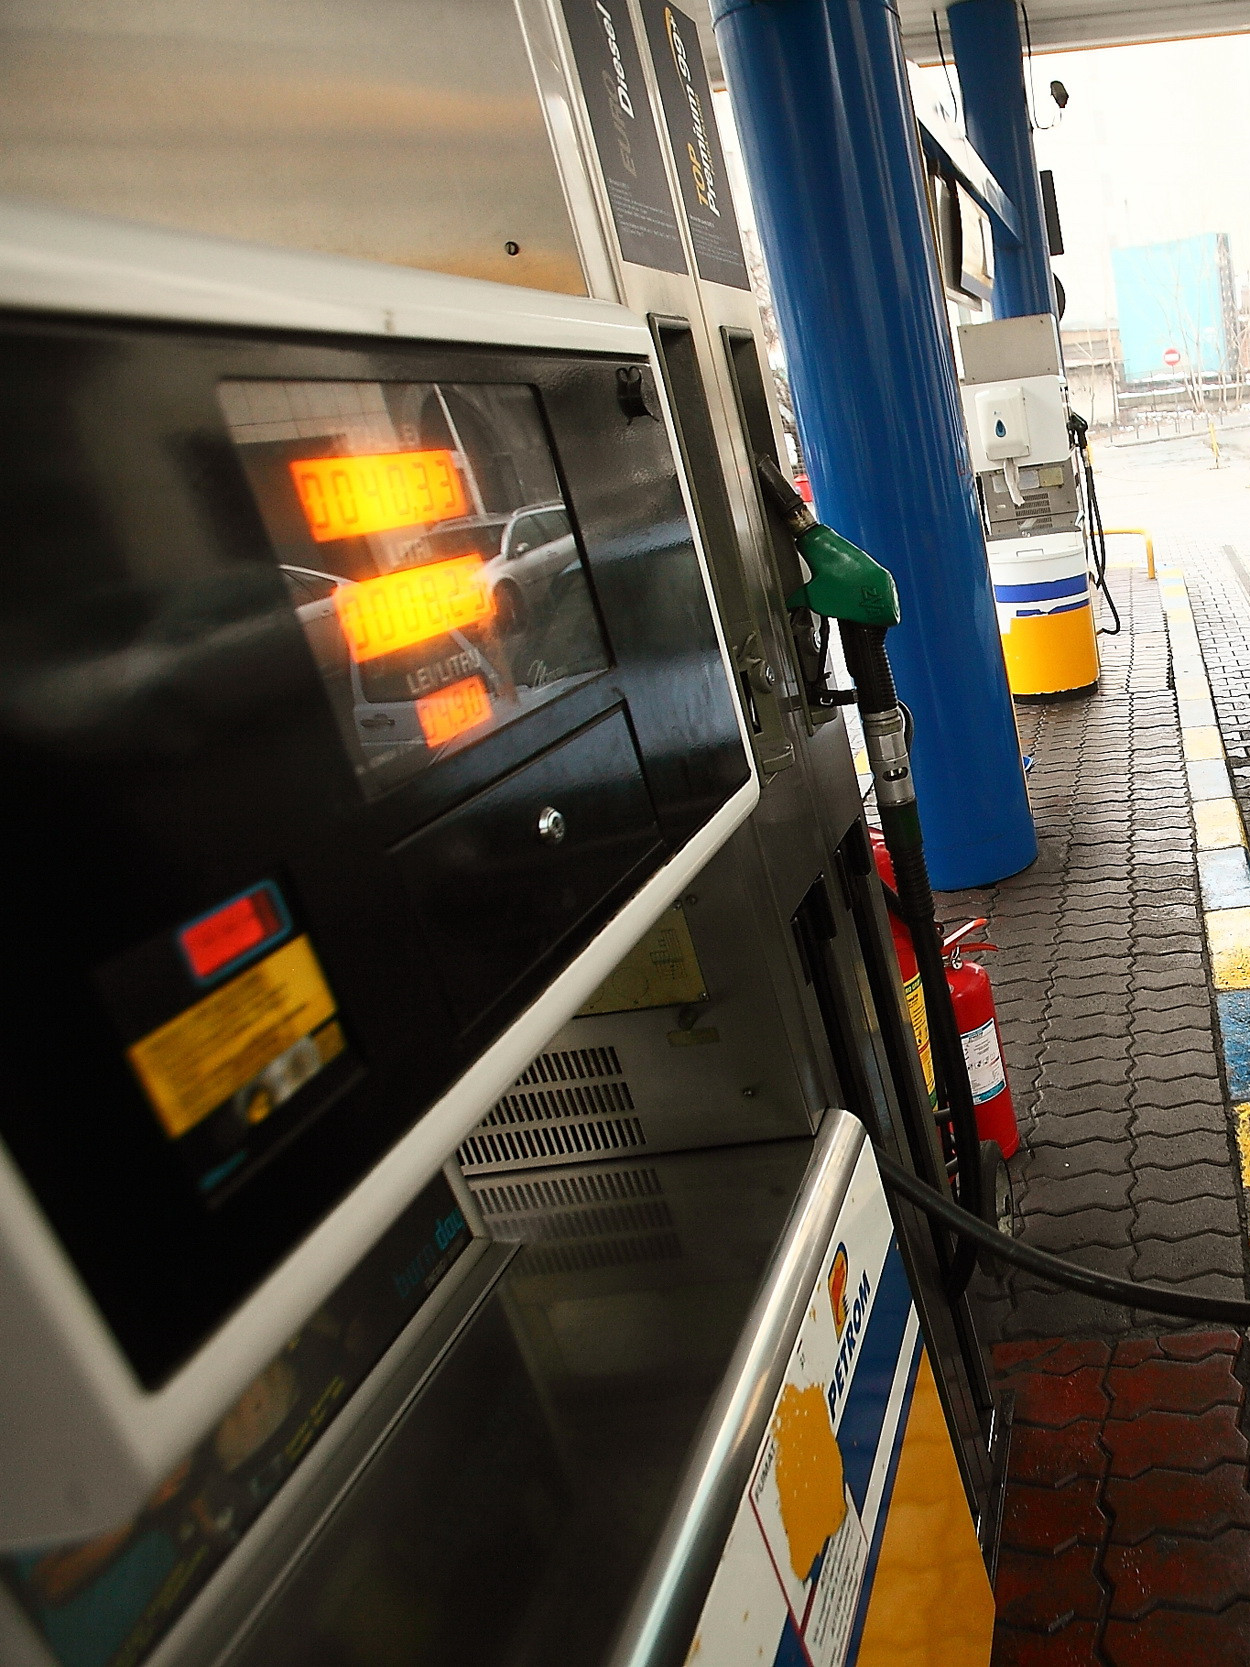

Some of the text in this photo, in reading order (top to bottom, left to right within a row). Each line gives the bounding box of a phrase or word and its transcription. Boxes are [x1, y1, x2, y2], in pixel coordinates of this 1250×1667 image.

[596, 0, 635, 120] Diesel
[686, 83, 721, 218] Premium
[687, 142, 709, 207] TOP
[827, 1269, 871, 1424] PETROM
